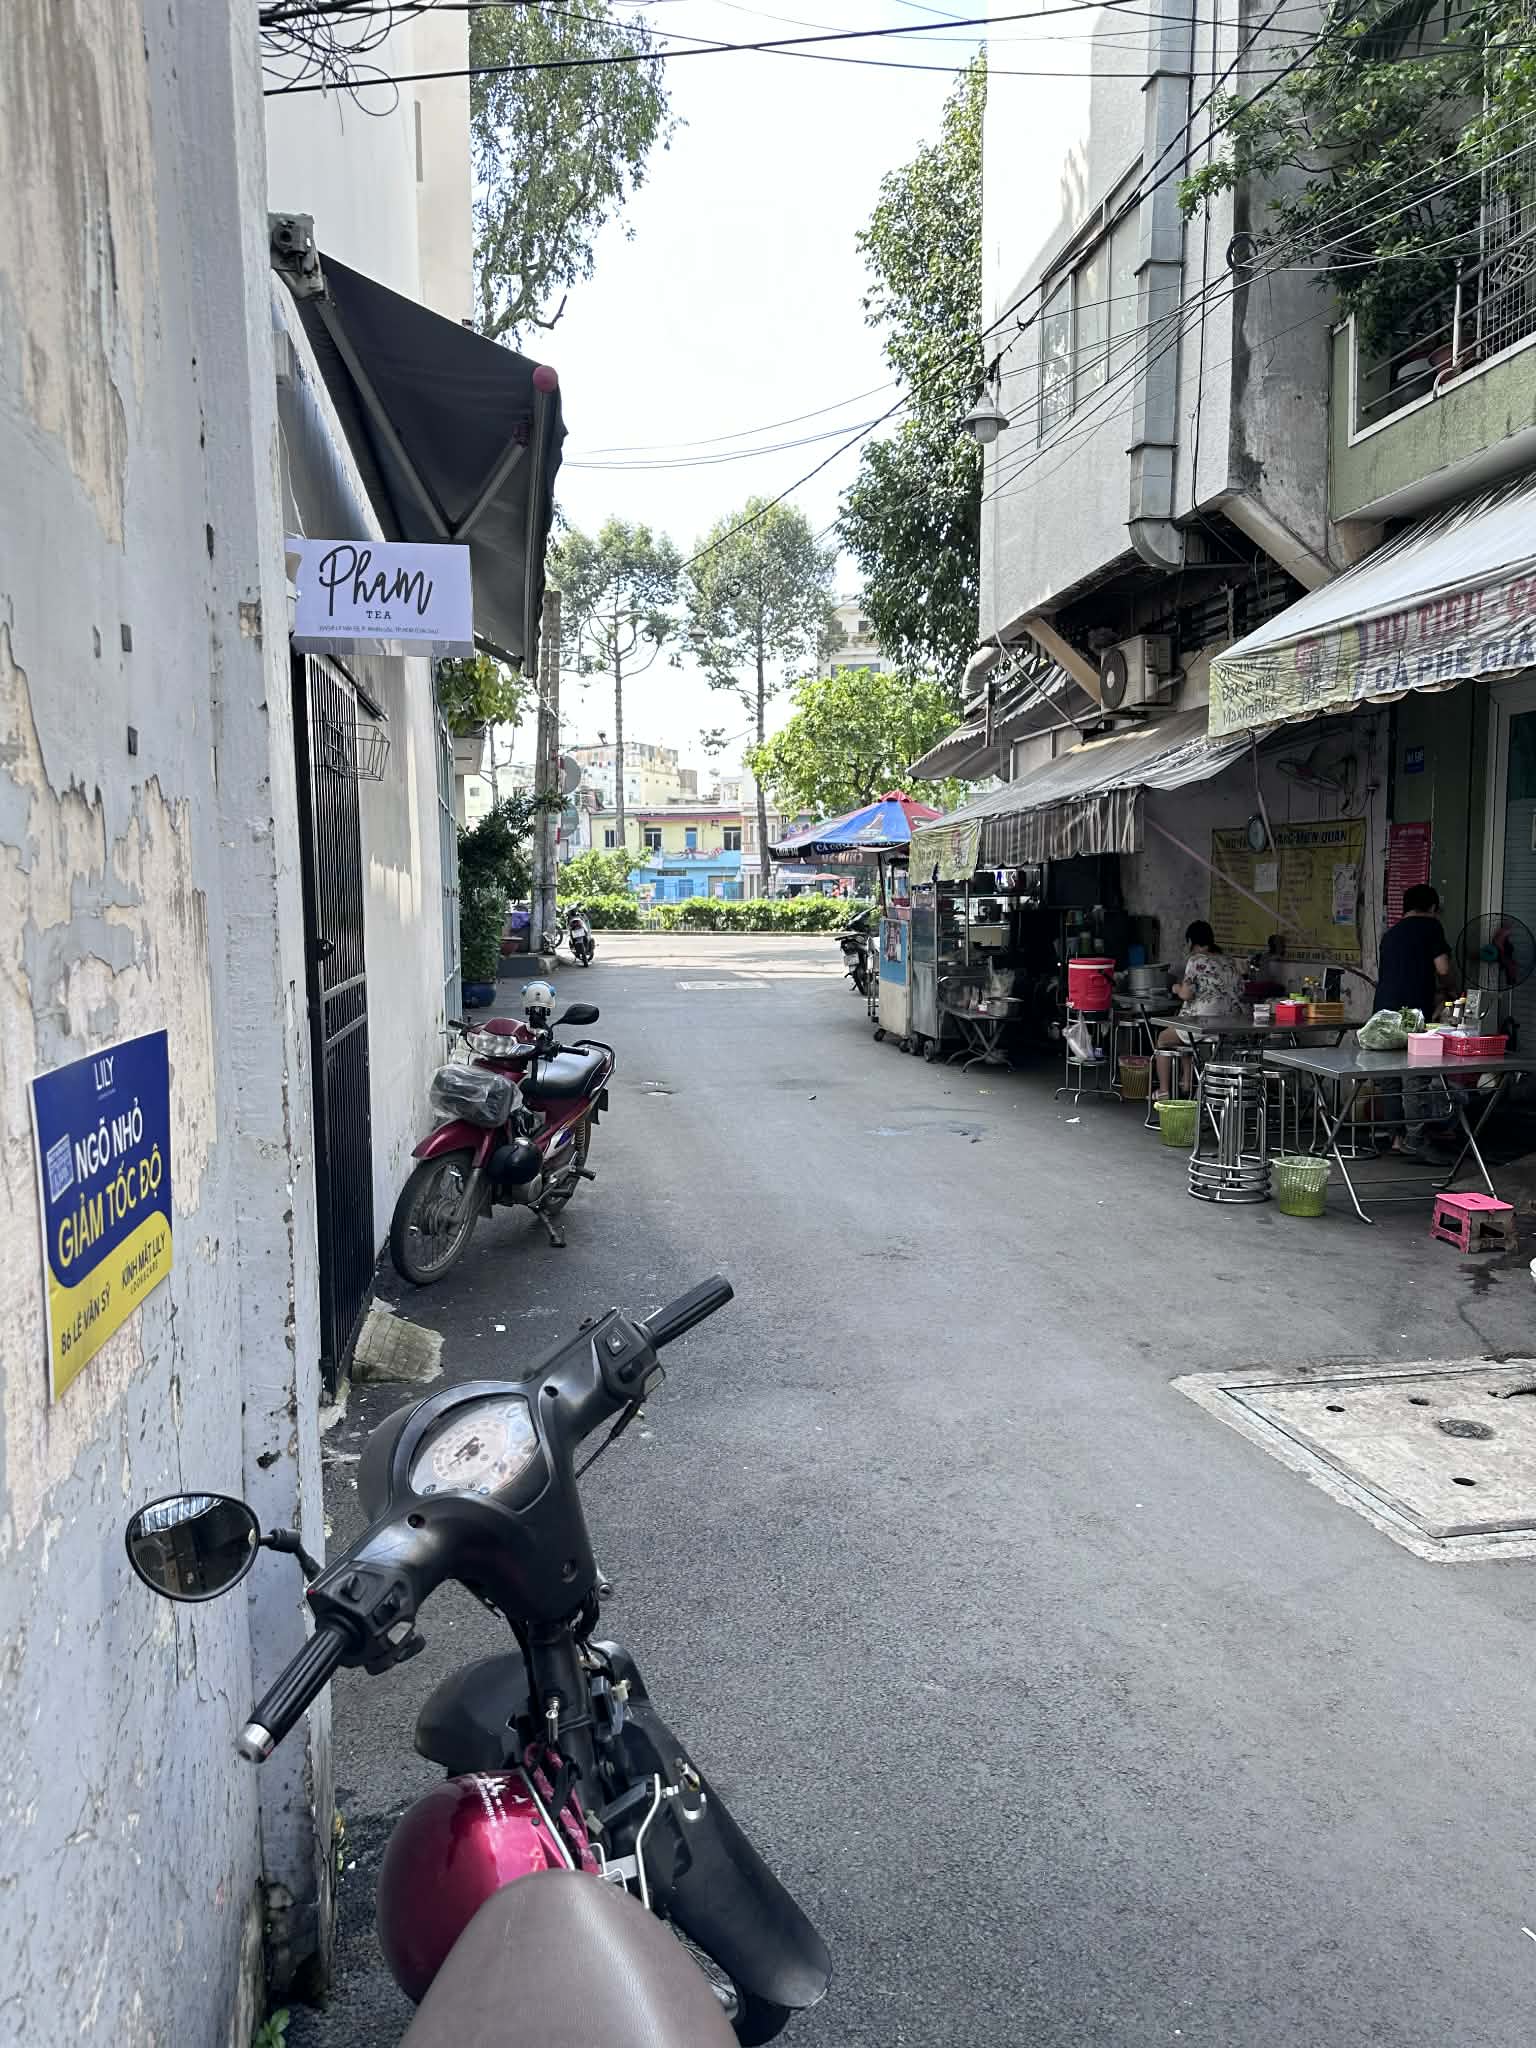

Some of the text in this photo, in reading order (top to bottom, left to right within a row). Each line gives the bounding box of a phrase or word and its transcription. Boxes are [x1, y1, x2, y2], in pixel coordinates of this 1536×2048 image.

[318, 544, 433, 617] Pham
[366, 610, 393, 620] TEA
[94, 1055, 115, 1091] LILY
[75, 1116, 110, 1183] NGÕ
[112, 1096, 143, 1158] NHỎ
[58, 1191, 105, 1269] GIẢM
[105, 1160, 137, 1227] TỐC
[140, 1143, 161, 1200] ĐỘ
[152, 1231, 166, 1258] LILY
[61, 1328, 73, 1356] 86
